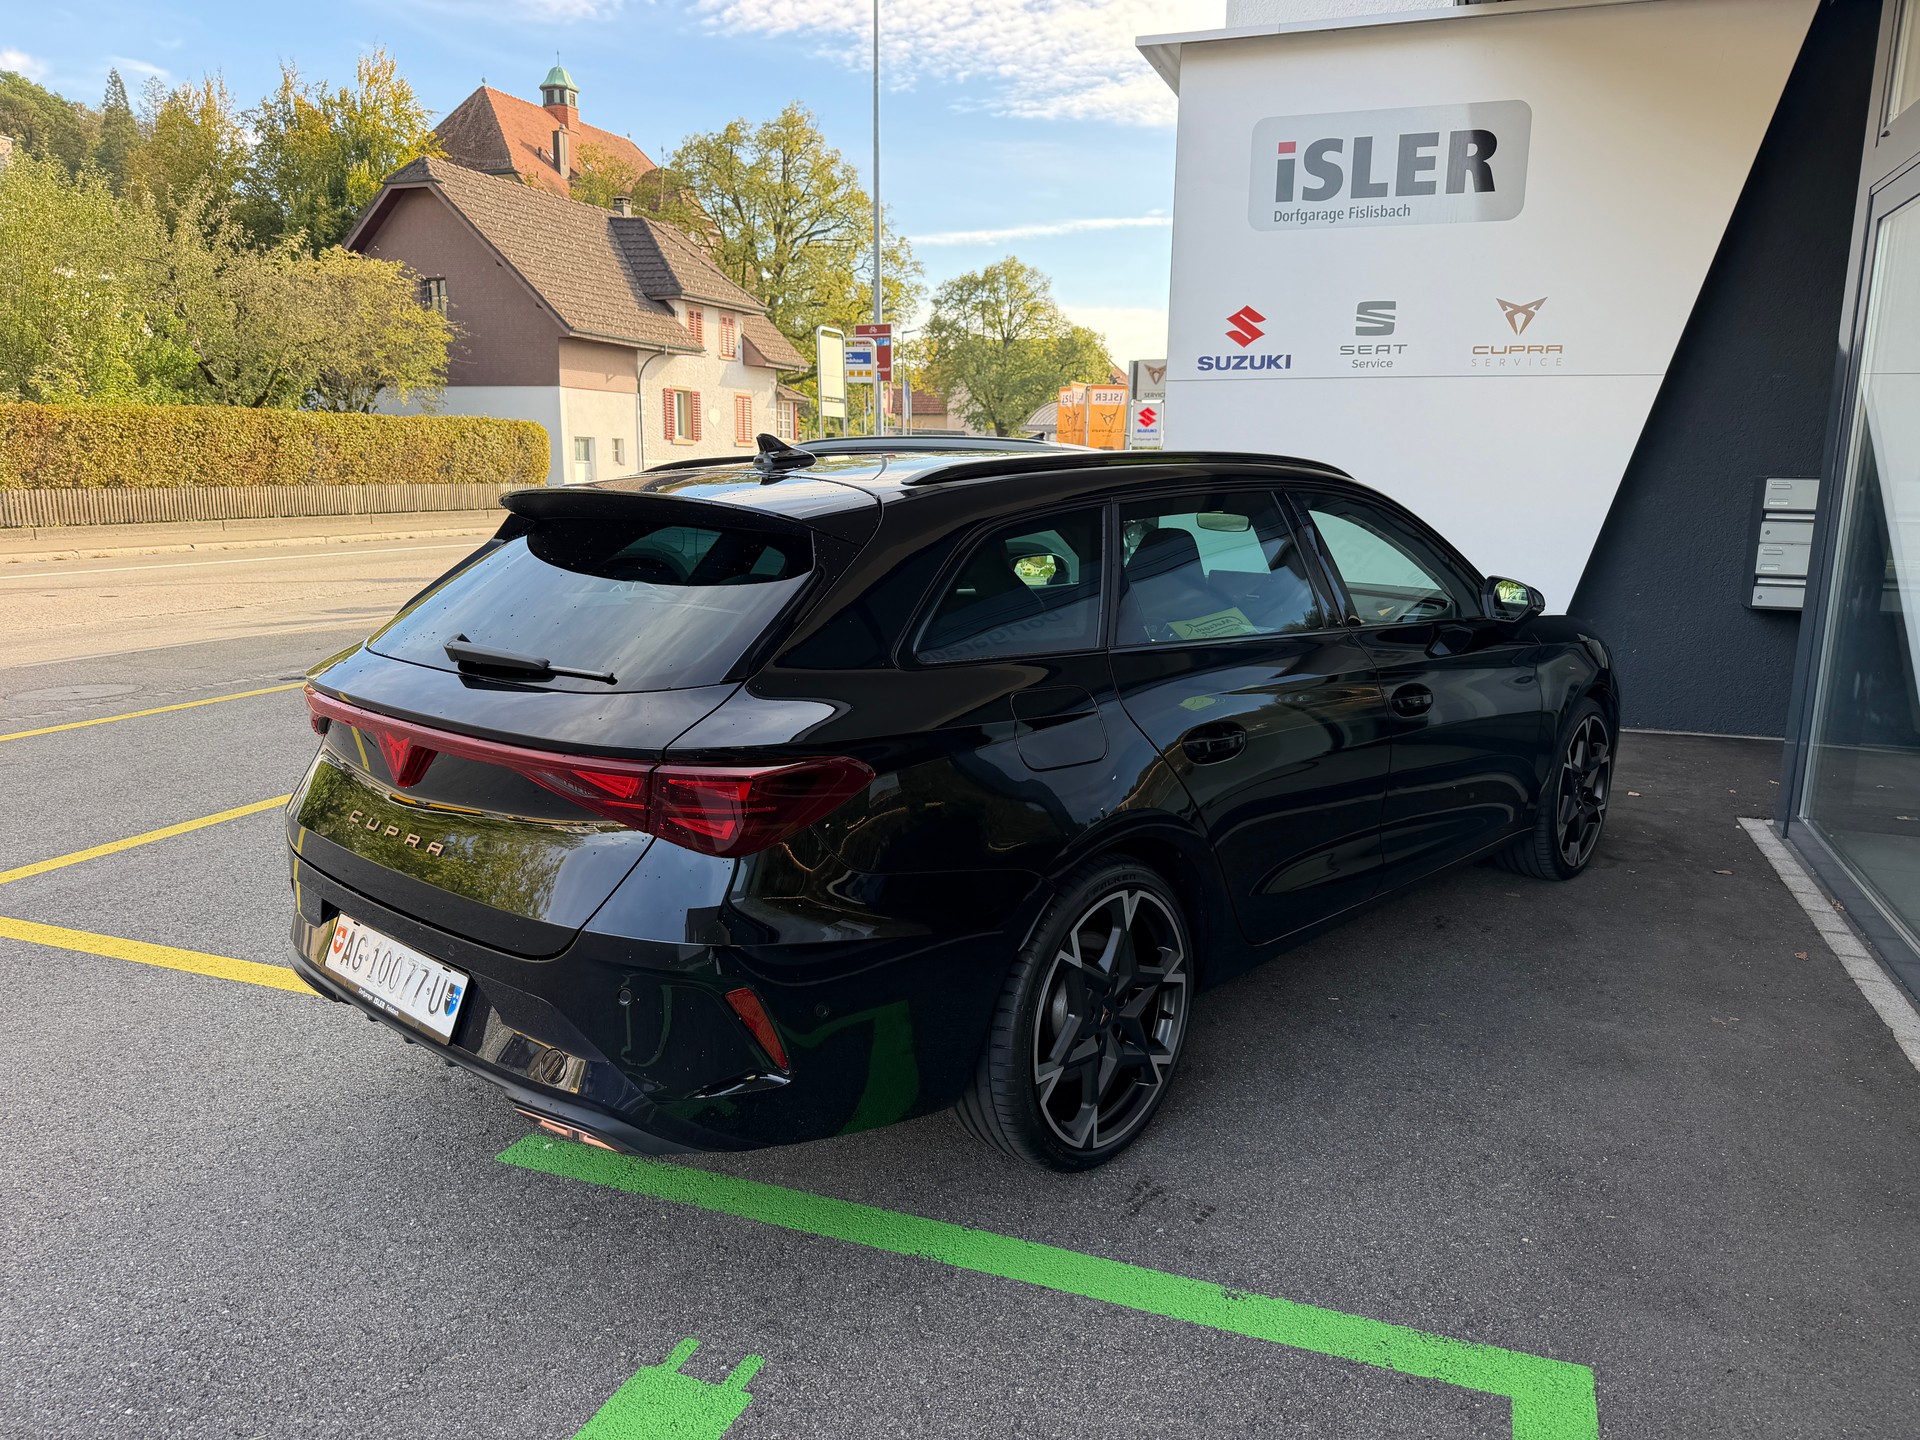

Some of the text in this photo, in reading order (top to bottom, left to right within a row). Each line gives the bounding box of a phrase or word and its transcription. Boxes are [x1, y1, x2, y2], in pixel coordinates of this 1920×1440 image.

[1273, 204, 1411, 225] Dorfgarage Fislisbach
[1339, 344, 1408, 356] SEAT
[1472, 344, 1563, 355] CUPRA
[1197, 354, 1292, 371] SUZUKI
[1351, 358, 1394, 369] Service
[1471, 357, 1562, 367] SERVICE
[349, 809, 444, 857] CUPRA
